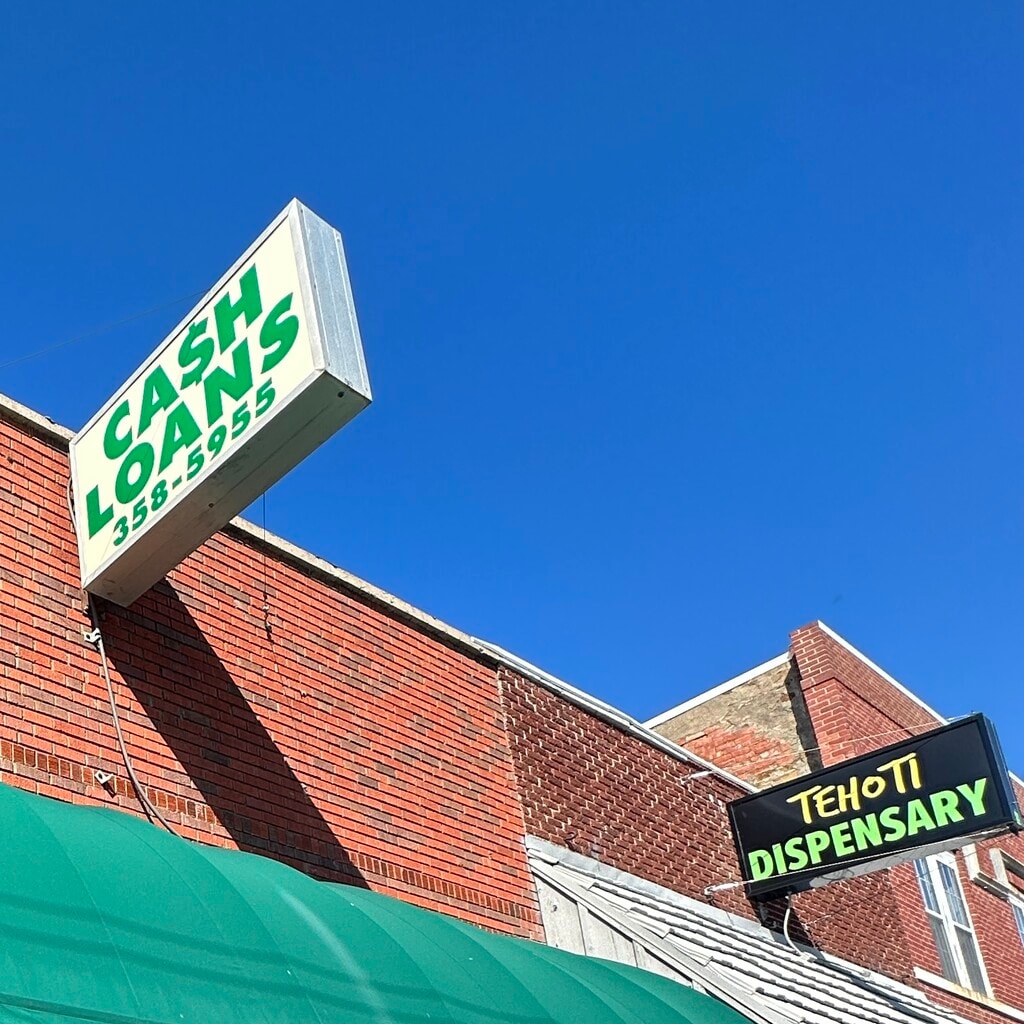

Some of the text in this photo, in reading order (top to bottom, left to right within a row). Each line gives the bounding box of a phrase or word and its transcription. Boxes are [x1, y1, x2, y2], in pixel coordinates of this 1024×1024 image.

[86, 292, 300, 539] LOANS
[112, 376, 277, 547] 358-5955
[747, 777, 988, 881] DISPENSARY
[785, 752, 923, 824] TEHOTI
